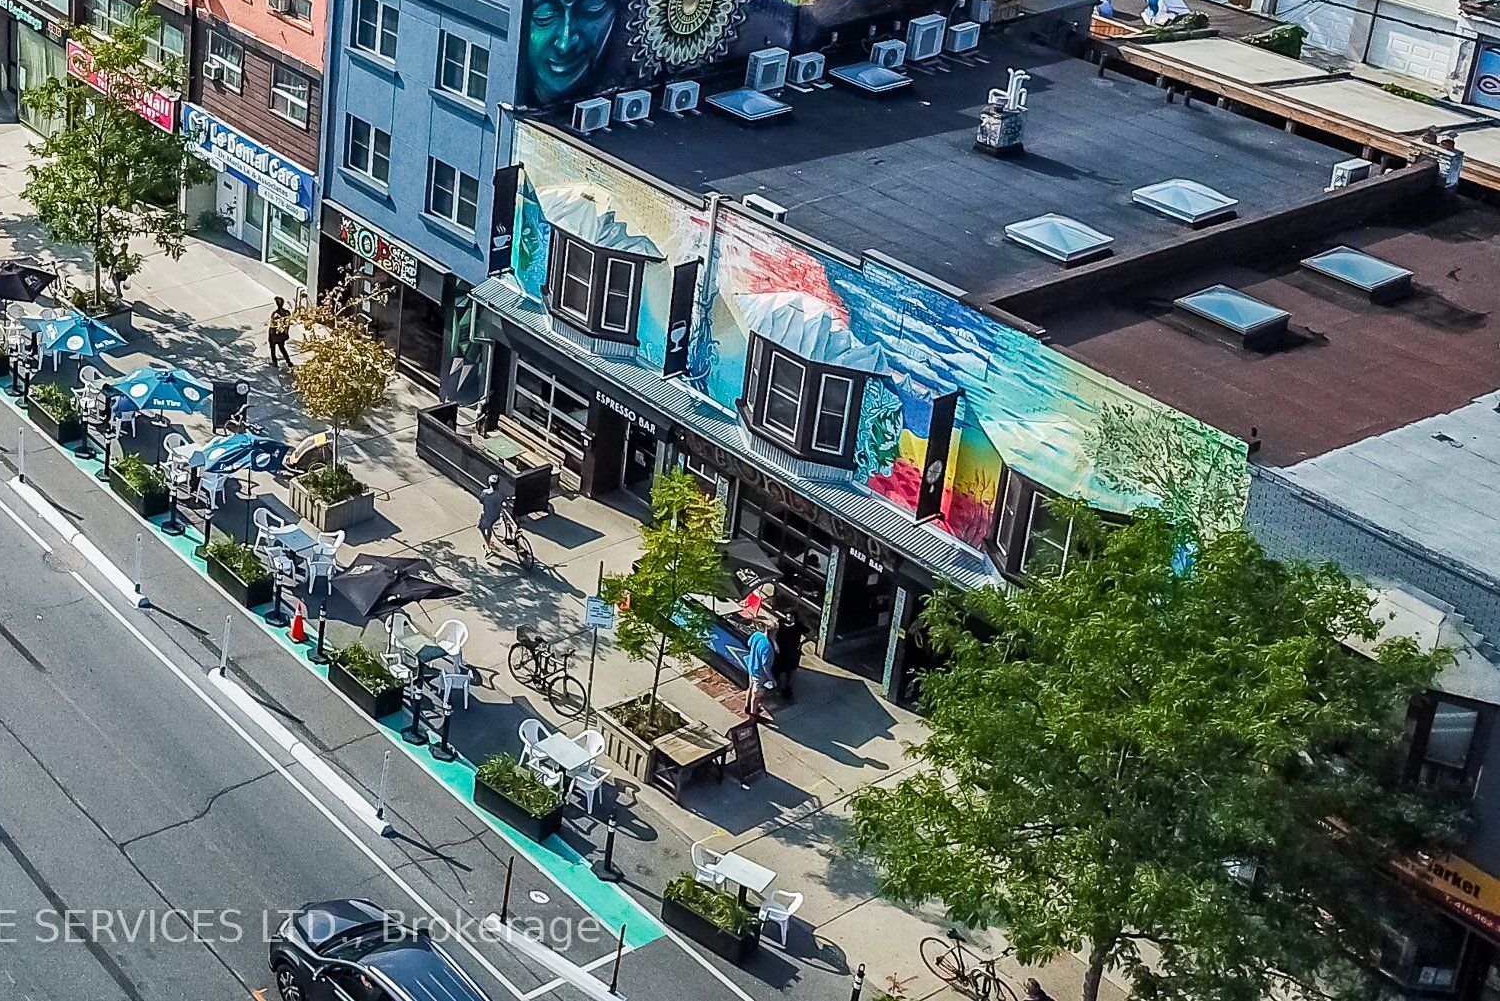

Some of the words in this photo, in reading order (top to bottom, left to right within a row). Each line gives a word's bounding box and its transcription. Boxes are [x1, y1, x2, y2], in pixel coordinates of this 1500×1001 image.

[143, 90, 170, 117] Nail
[210, 121, 227, 148] Le
[226, 131, 269, 173] Dental
[269, 158, 301, 191] Care
[595, 390, 637, 421] ESPRESSO
[638, 416, 656, 435] BAR
[850, 547, 866, 563] BEER
[869, 558, 884, 573] BAR
